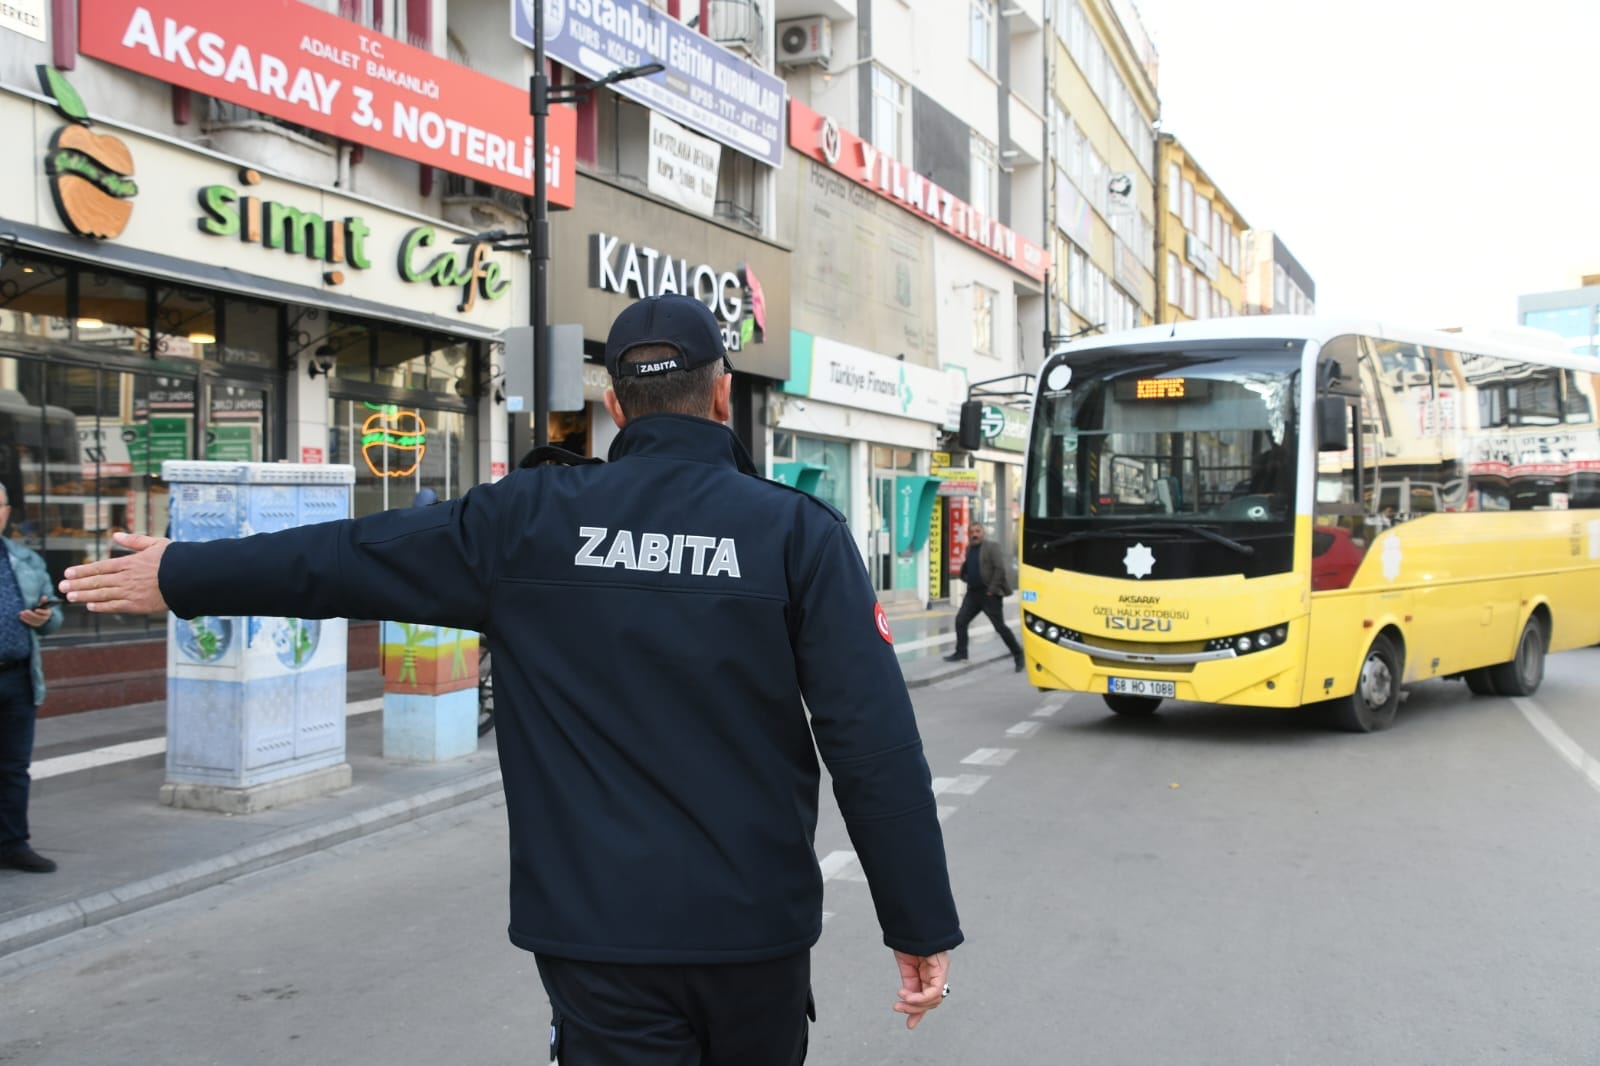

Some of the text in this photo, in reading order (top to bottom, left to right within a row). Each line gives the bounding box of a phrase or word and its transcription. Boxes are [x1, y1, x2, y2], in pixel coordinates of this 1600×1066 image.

[122, 7, 341, 116] AKSARAY
[351, 87, 383, 132] 3.
[300, 35, 440, 100] ADALET BAKANLIĞI
[715, 63, 780, 122] KURUMLARI
[860, 142, 954, 227] YILMAZ
[598, 232, 743, 323] KATALOG
[640, 360, 678, 373] ZABITA
[830, 361, 865, 392] Türkiye
[574, 526, 741, 578] ZABITA
[1093, 606, 1189, 619] ÖZEL HALK OTOBÜSÜ
[1119, 595, 1160, 604] AKSARAY
[1105, 617, 1172, 631] ISUZU
[1115, 679, 1174, 695] 68 HO 1088
